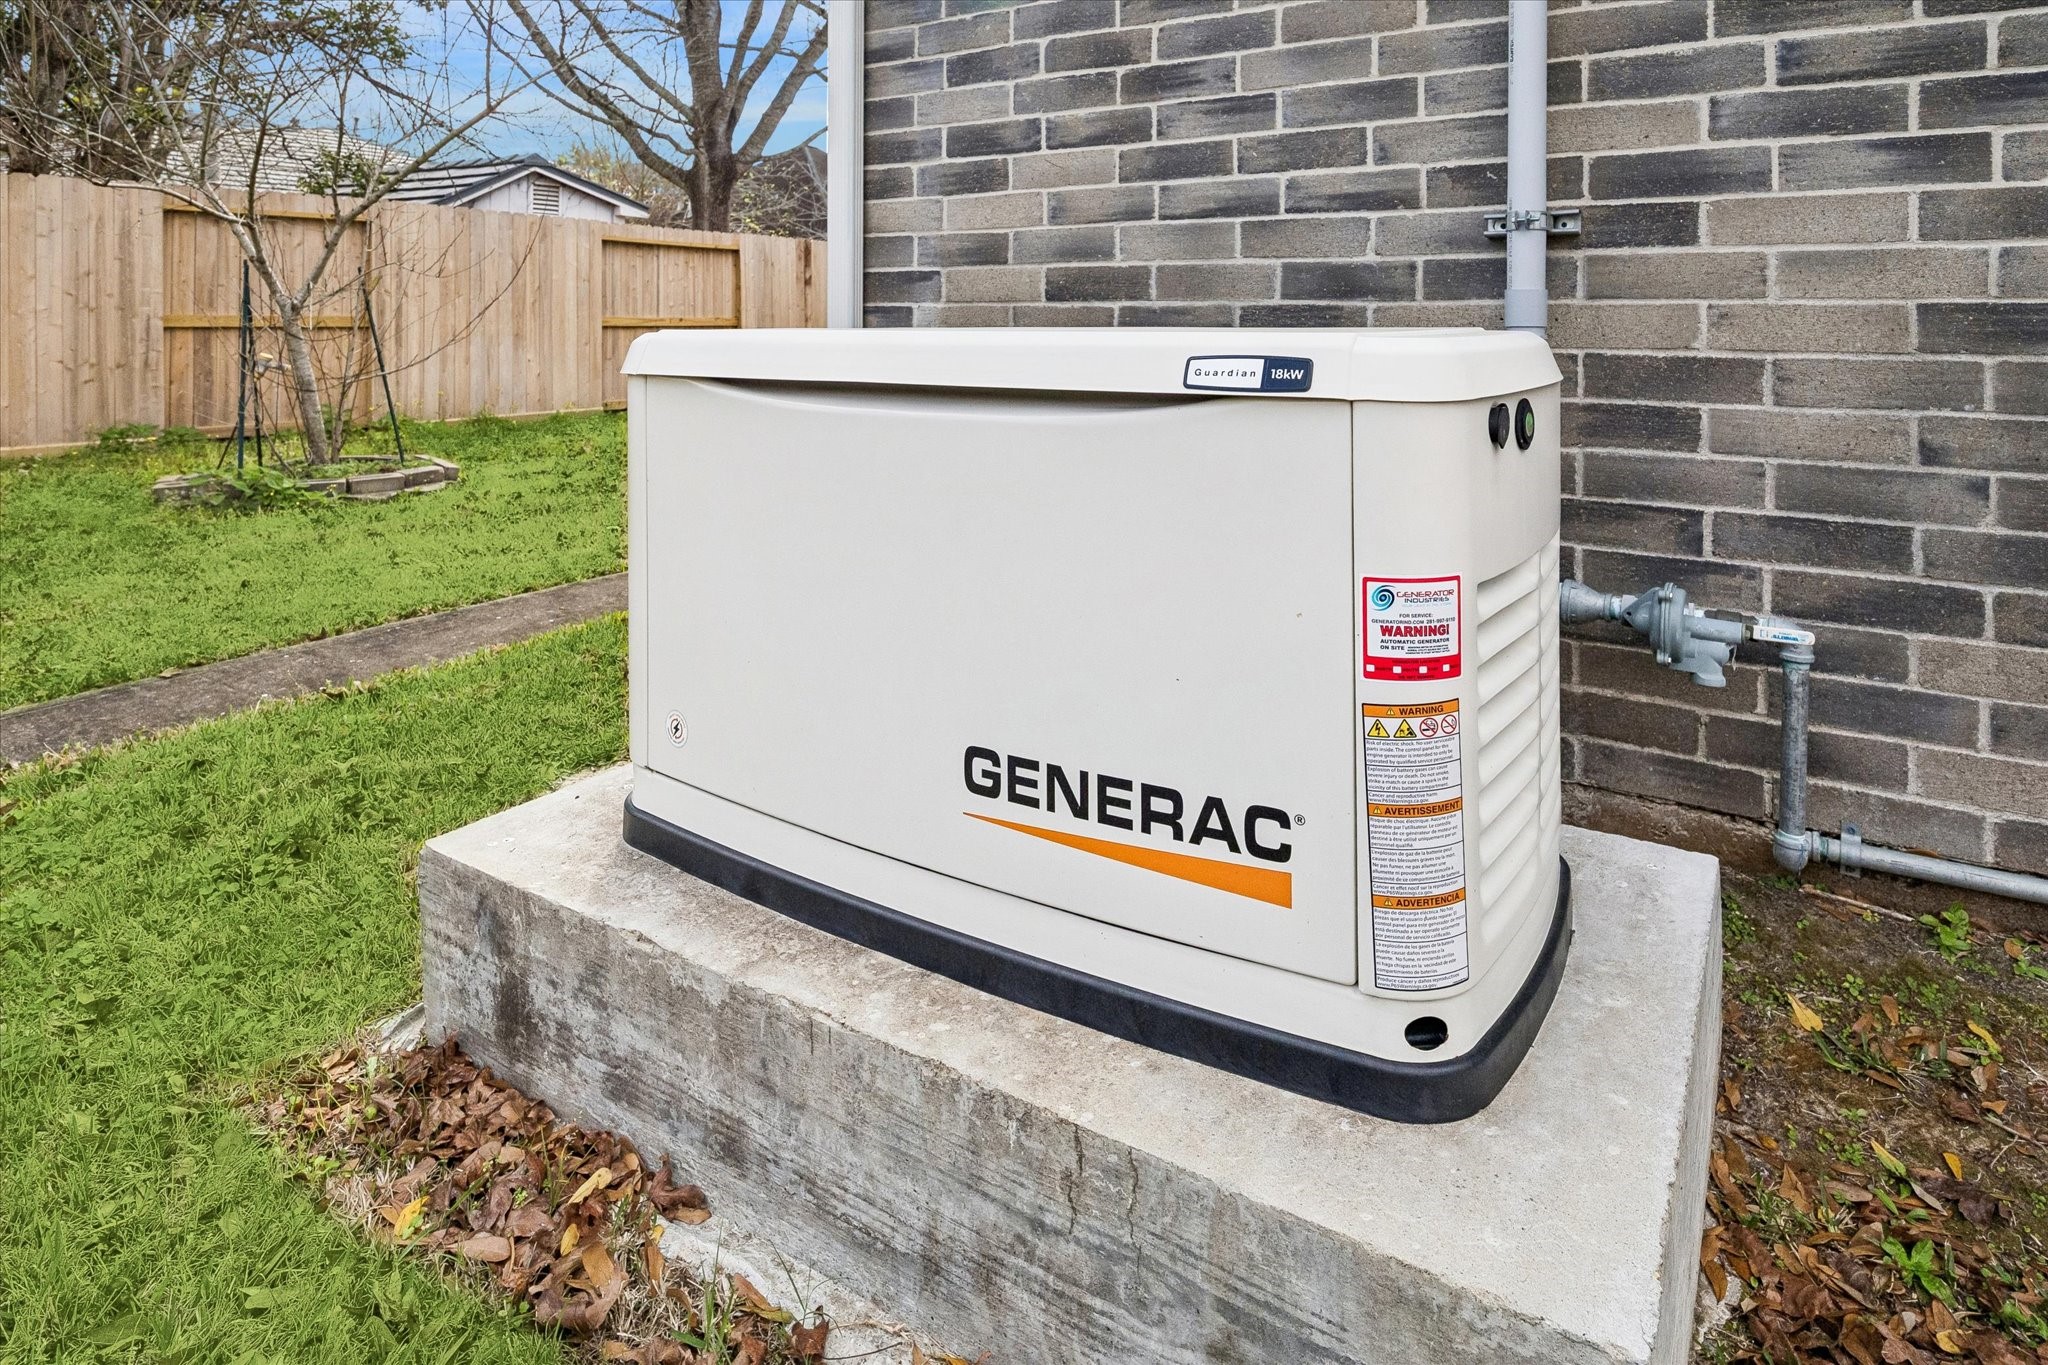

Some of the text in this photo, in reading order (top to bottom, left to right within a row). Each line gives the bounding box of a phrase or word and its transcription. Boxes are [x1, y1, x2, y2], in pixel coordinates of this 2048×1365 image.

[1194, 368, 1304, 379] Guardian 18kW
[1397, 589, 1454, 597] GENERATOR
[1380, 624, 1449, 637] WARNING!
[1399, 706, 1444, 715] WARNING
[1385, 801, 1460, 815] AVERTISSEMENT
[1396, 893, 1460, 907] ADVERTENCIA
